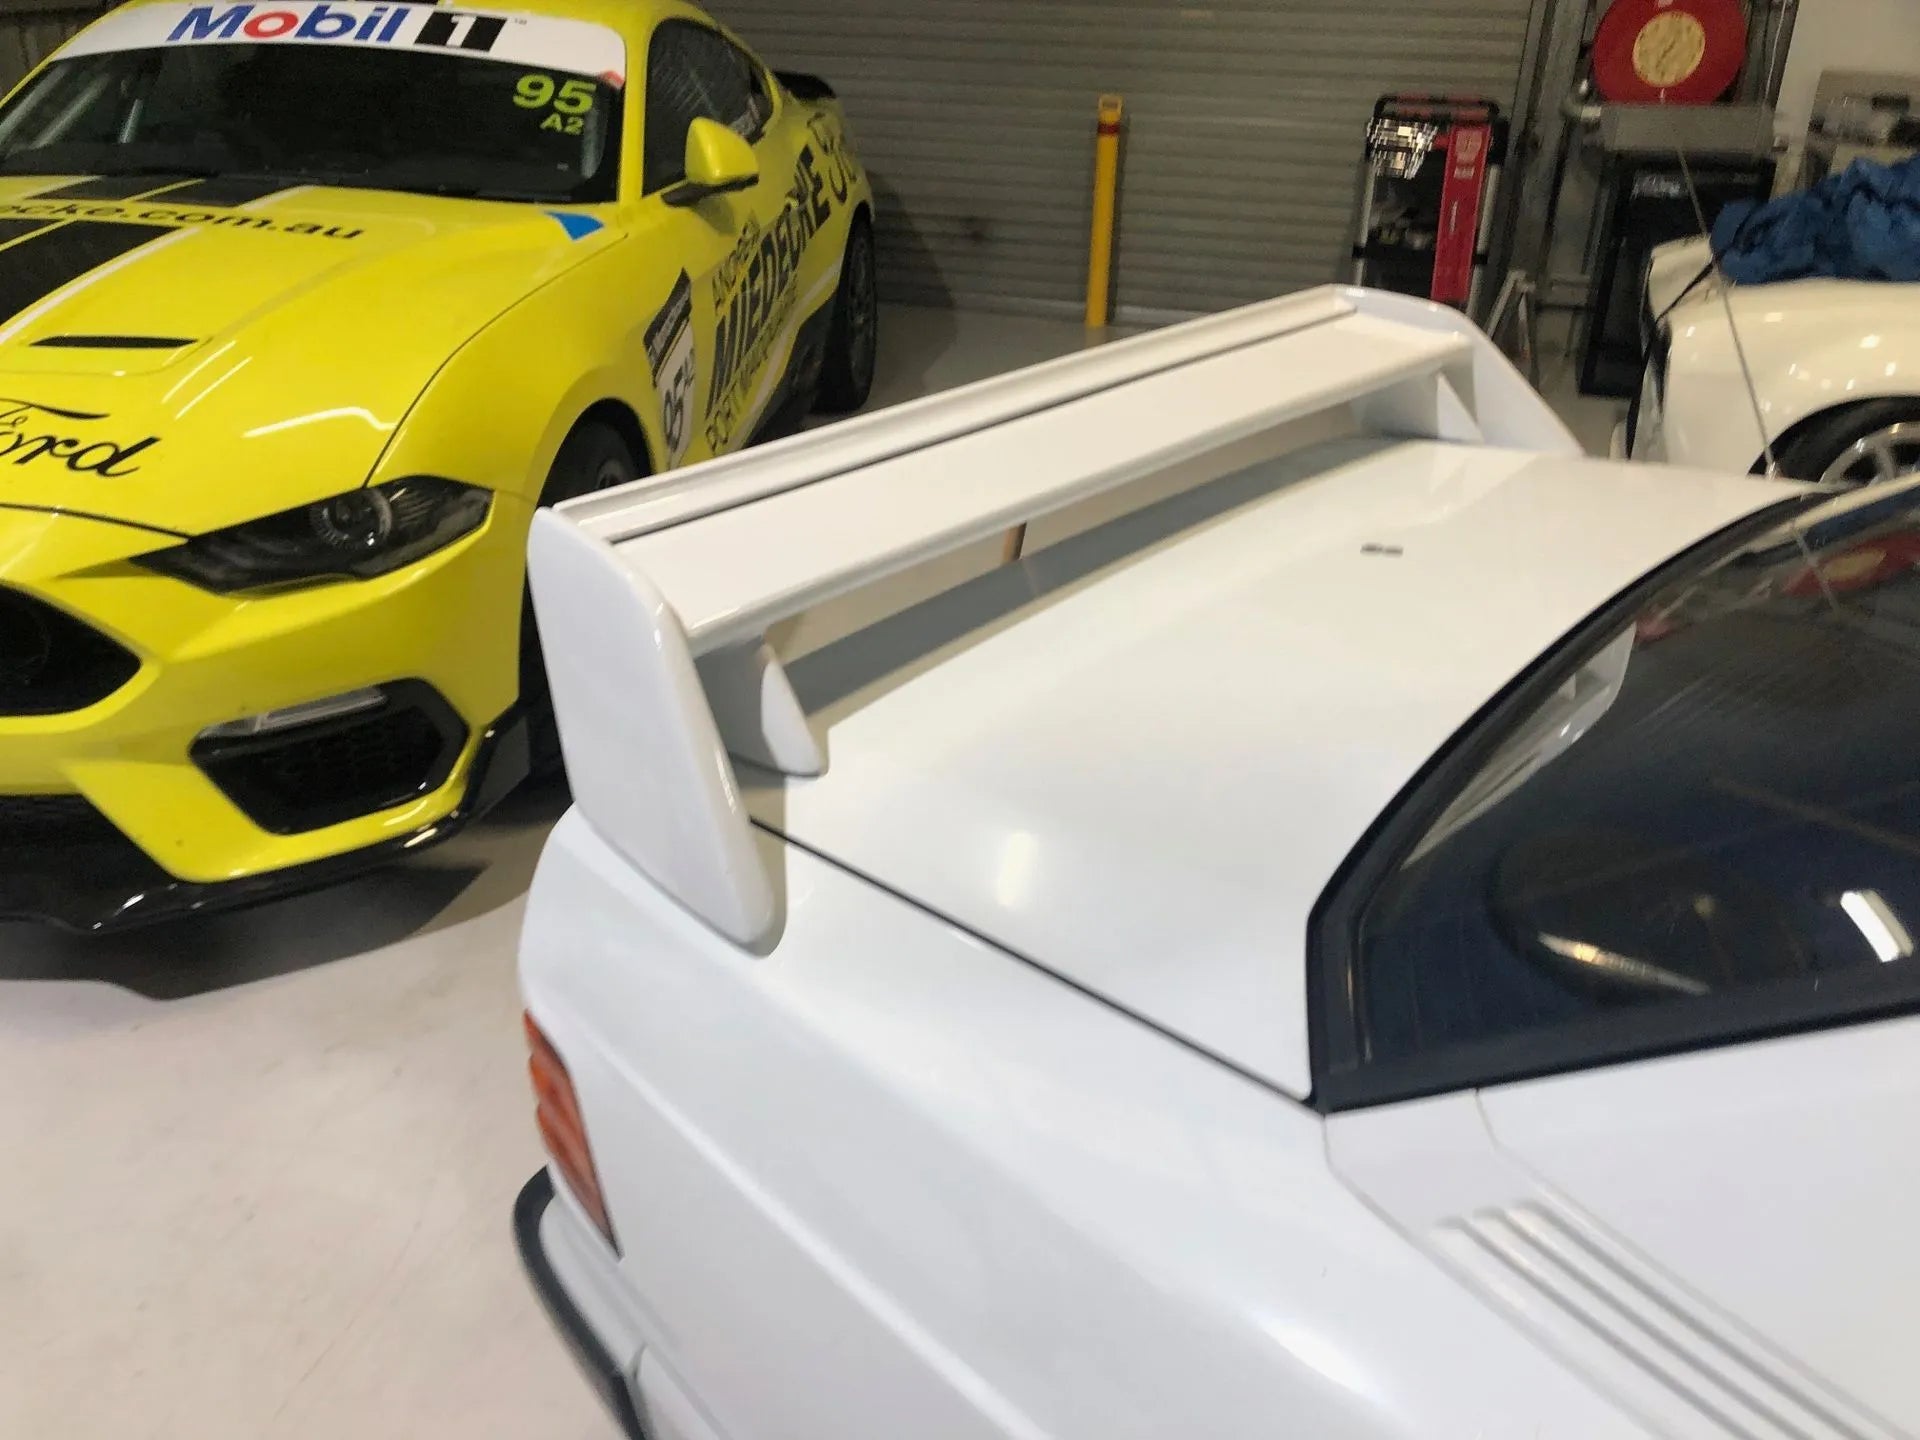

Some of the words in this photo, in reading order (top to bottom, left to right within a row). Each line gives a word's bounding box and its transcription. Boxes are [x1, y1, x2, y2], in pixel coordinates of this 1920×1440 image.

[166, 3, 412, 42] Mobil
[513, 73, 597, 115] 95
[540, 112, 585, 135] A2
